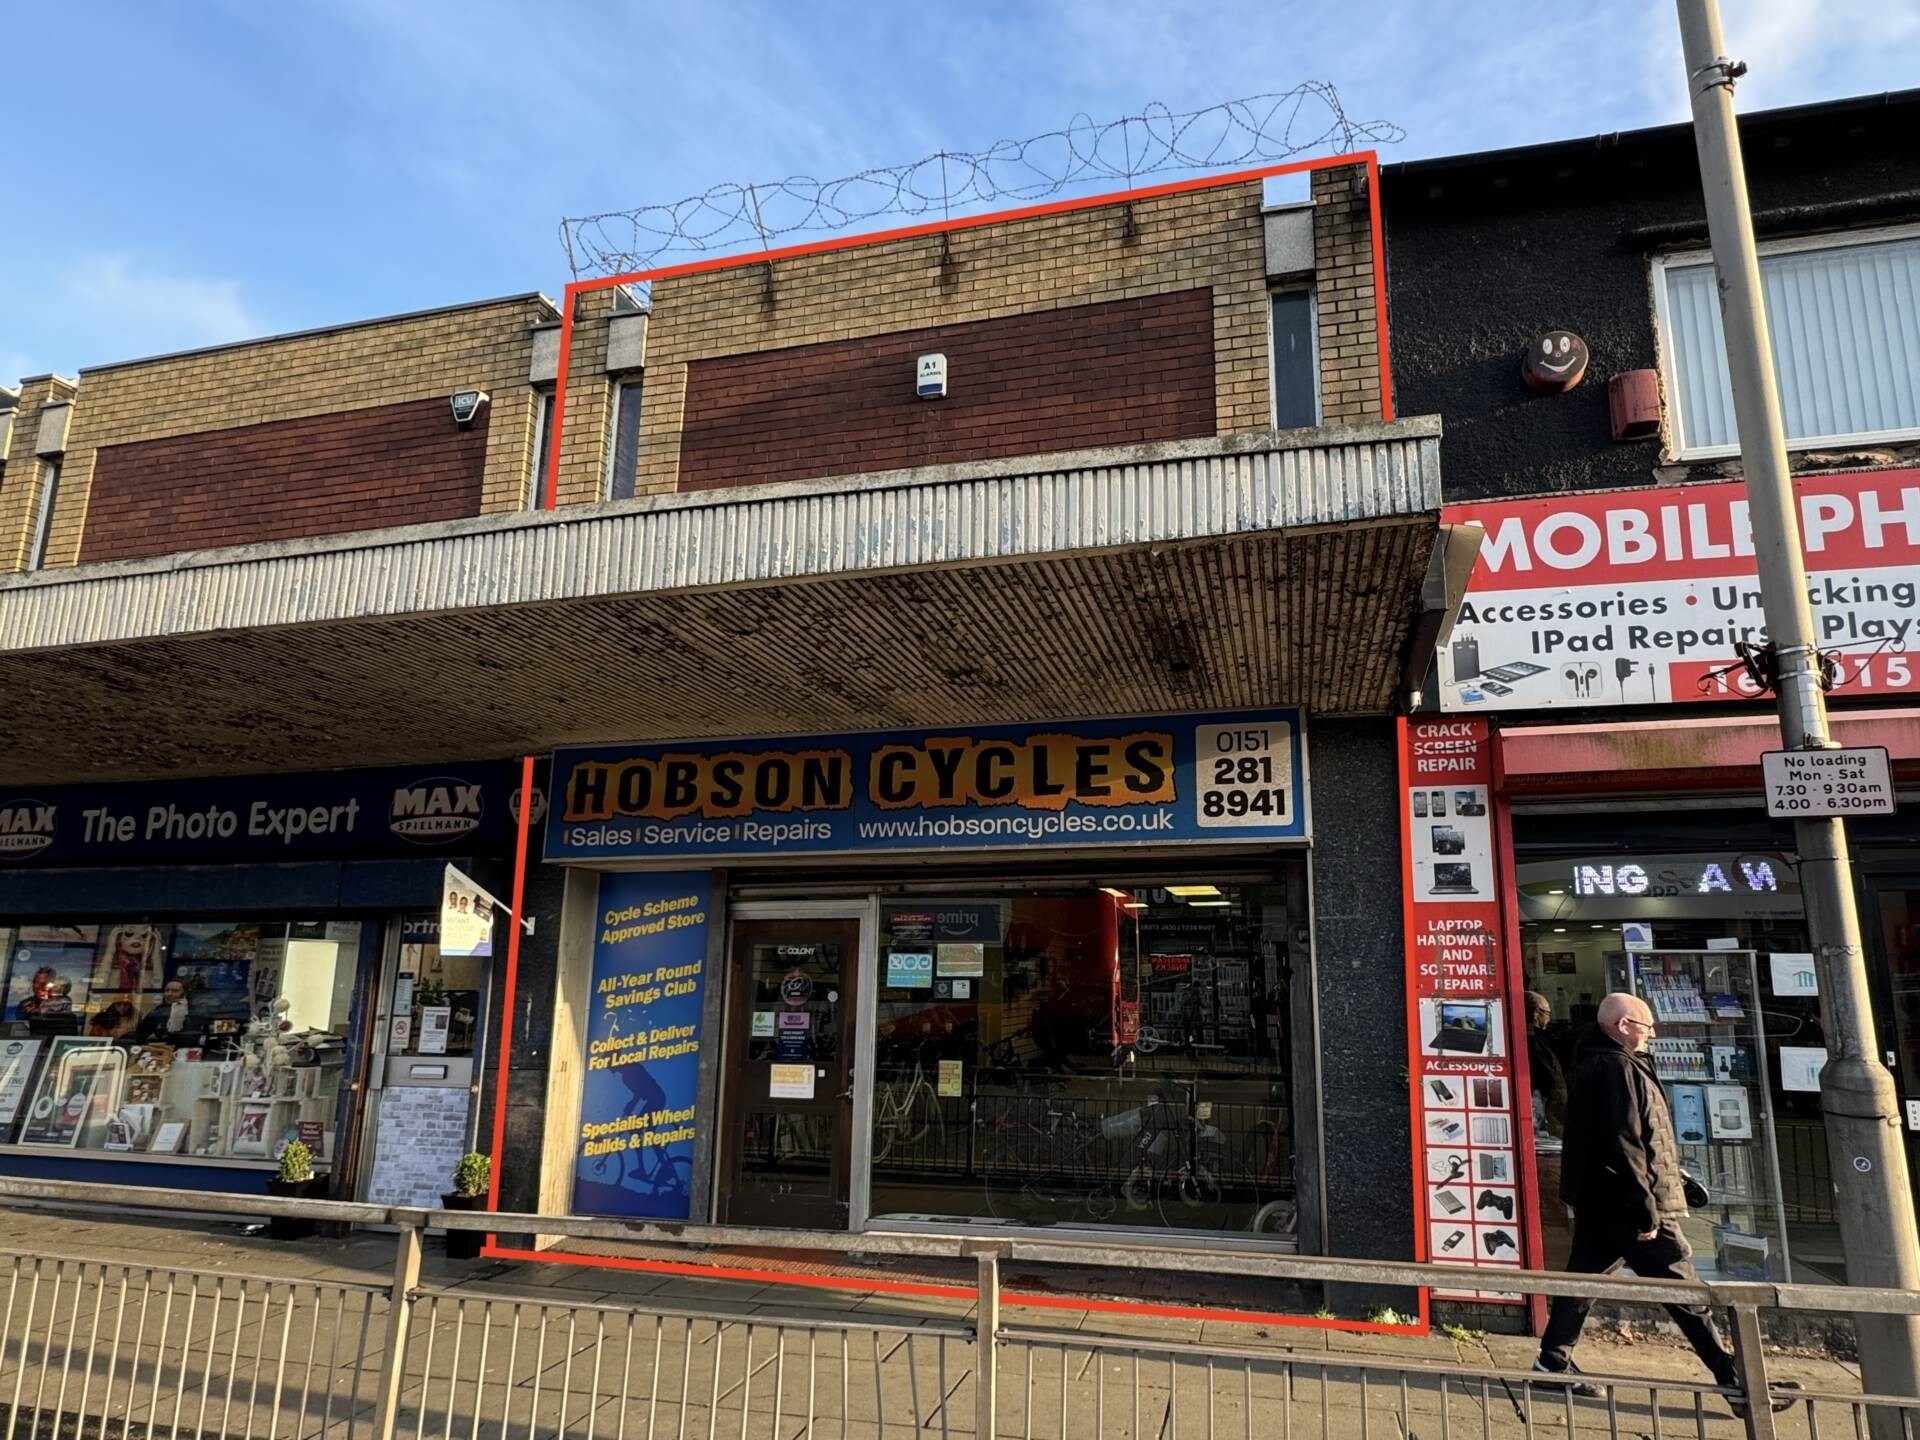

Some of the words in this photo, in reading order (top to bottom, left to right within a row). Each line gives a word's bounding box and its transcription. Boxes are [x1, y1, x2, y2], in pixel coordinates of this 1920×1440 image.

[924, 361, 936, 370] A1
[1456, 590, 1668, 625] Accessories
[1712, 577, 1915, 611] Uncking
[1531, 625, 1613, 654] IPad
[1216, 730, 1269, 752] 0151
[1417, 723, 1473, 738] CRACK
[1414, 740, 1477, 755] SCREEN
[1784, 757, 1805, 768] No
[1811, 755, 1866, 767] loading
[572, 756, 842, 815] HOBSON
[879, 740, 1165, 801] CYCLES
[1214, 756, 1272, 785] 281
[1417, 757, 1476, 772] REPAIR
[1789, 771, 1821, 781] Mon
[1839, 768, 1865, 779] Sat
[392, 785, 482, 816] MAX
[1203, 789, 1285, 818] 8941
[1775, 785, 1807, 796] 7.30
[1823, 783, 1882, 794] 930am
[1775, 799, 1811, 810] 4.00
[1827, 797, 1887, 809] 6.30pm
[82, 806, 136, 842] The
[146, 803, 237, 841] Photo
[248, 798, 360, 845] Expert
[397, 818, 472, 832] SPIELMANN
[571, 825, 632, 846] Sales
[644, 822, 730, 844] Service
[743, 819, 831, 845] Repairs
[859, 808, 1174, 838] www.hobsoncycles.co.uk
[605, 906, 641, 926] Cycle
[643, 895, 699, 917] Scheme
[601, 918, 665, 944] Approved
[667, 912, 705, 930] Store
[1428, 920, 1483, 932] LAPTOP
[1442, 949, 1473, 960] AND
[597, 972, 653, 993] All-Year
[656, 960, 702, 981] Round
[605, 987, 661, 1009] Savings
[664, 978, 697, 997] Club
[590, 1035, 634, 1054] Collect
[637, 1031, 647, 1046] &
[650, 1025, 696, 1043] Deliver
[589, 1055, 610, 1071] For
[612, 1047, 646, 1067] Local
[649, 1040, 699, 1060] Repairs
[582, 1112, 649, 1140] Specialist
[652, 1105, 695, 1126] Wheel
[584, 1134, 626, 1157] Builds
[629, 1133, 640, 1149] &
[642, 1126, 696, 1148] Repairs
